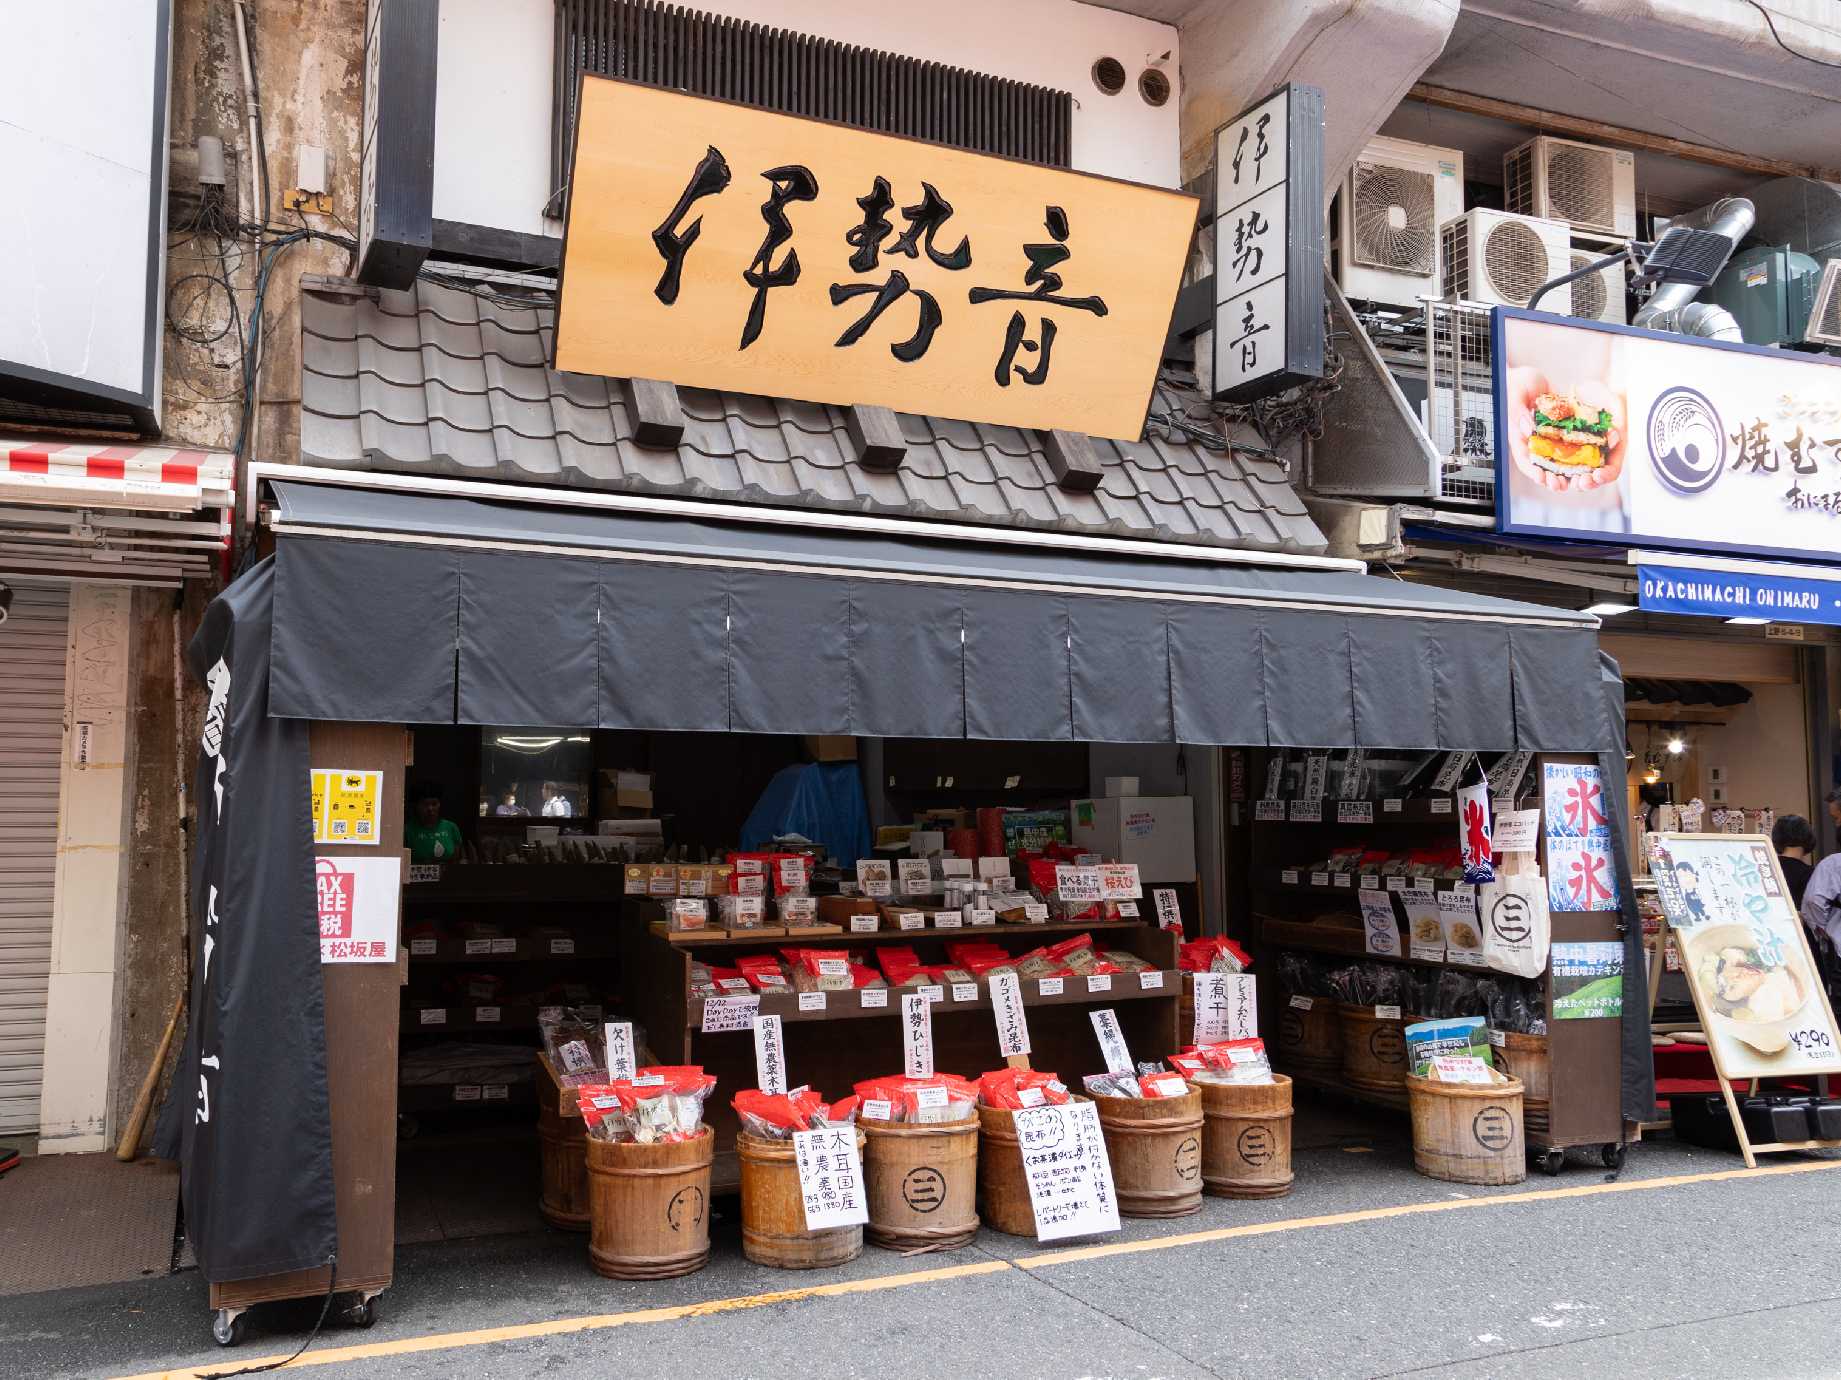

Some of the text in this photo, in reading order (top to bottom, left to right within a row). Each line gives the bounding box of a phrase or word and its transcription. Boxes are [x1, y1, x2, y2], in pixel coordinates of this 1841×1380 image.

[1230, 112, 1272, 374] 伊勢音
[652, 145, 1108, 387] 伊勢音
[1645, 580, 1819, 610] OKACHIMACHI ONIMARU
[1546, 765, 1603, 780] 懐かしい昭和の
[1564, 778, 1609, 837] 氷
[317, 876, 343, 894] AX
[1104, 875, 1134, 889] 桜えび
[1441, 893, 1472, 905] とろろ昆布
[1567, 851, 1612, 911] 氷
[318, 893, 346, 912] EE
[1727, 852, 1786, 966] 冷や汁
[320, 914, 343, 936] 税
[330, 942, 386, 958] 松坂屋
[999, 976, 1022, 1053] ガゴメきざみ昆布
[1208, 976, 1229, 1017] 煮干
[908, 998, 925, 1074] 伊勢ひじき
[1788, 1029, 1830, 1051] ¥290
[810, 1134, 832, 1192] 無農薬
[830, 1130, 858, 1212] 木耳国産
